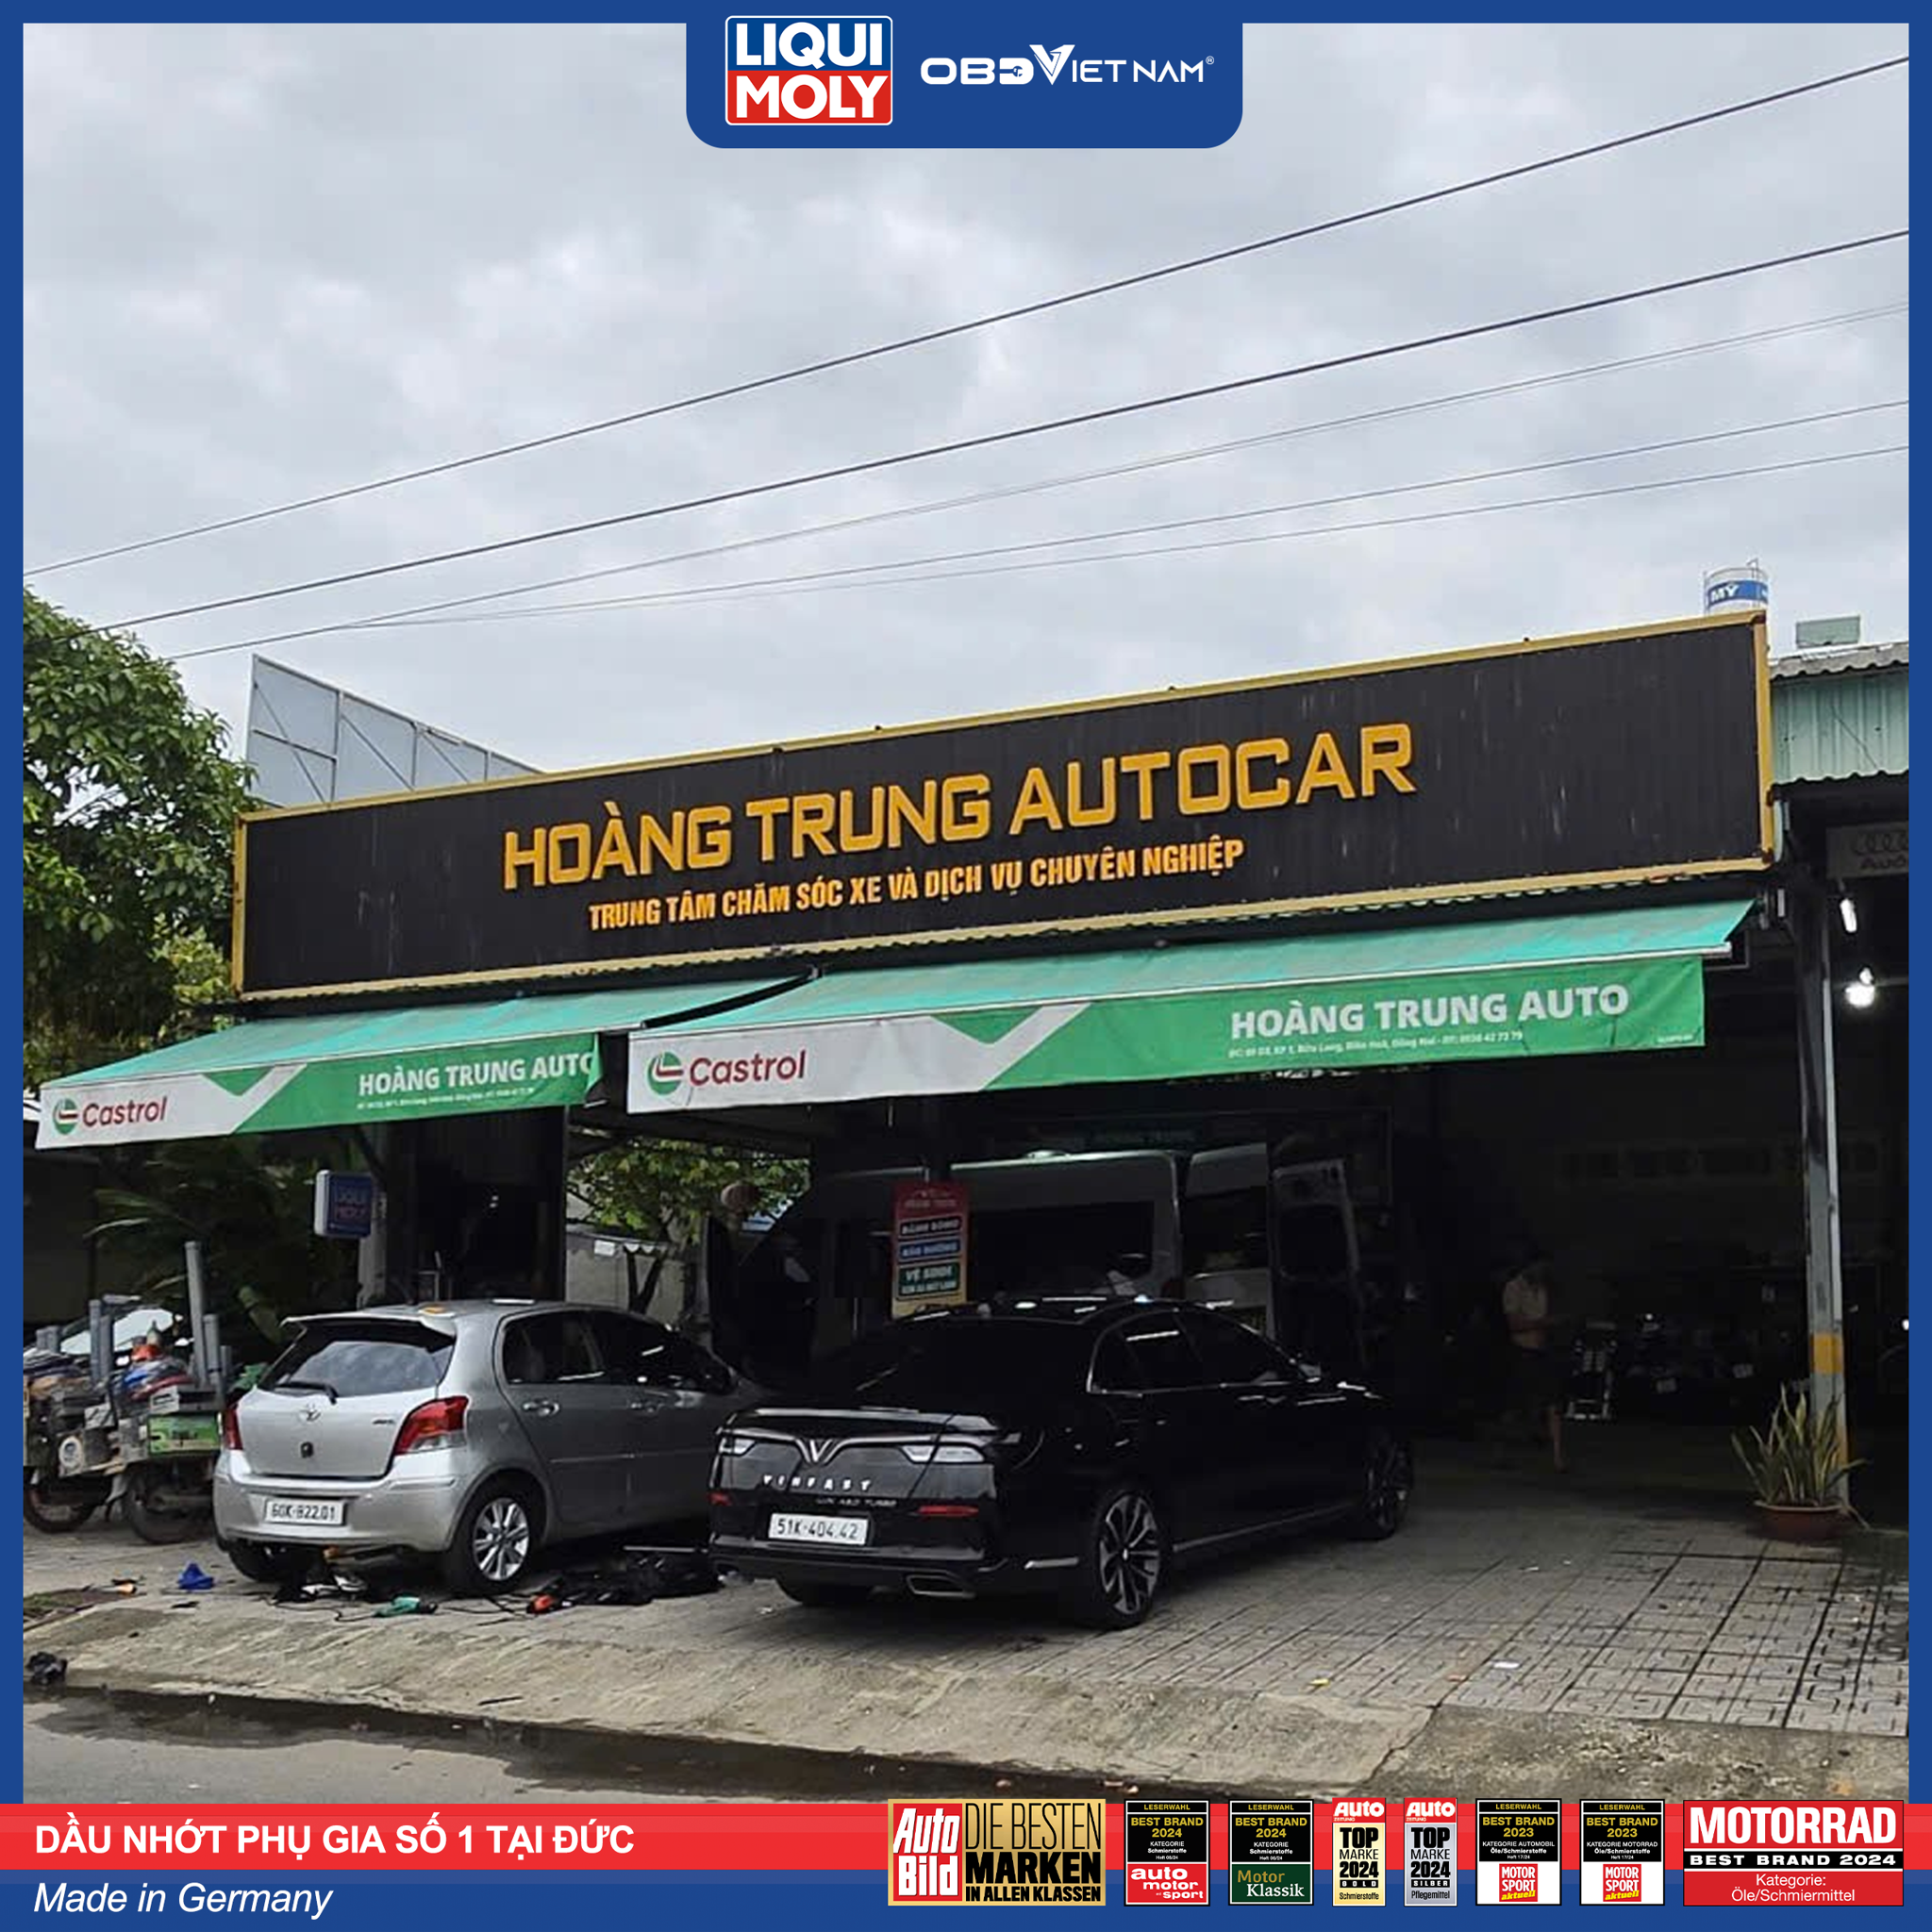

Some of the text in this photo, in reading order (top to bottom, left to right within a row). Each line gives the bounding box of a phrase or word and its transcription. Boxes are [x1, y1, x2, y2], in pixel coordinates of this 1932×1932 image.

[503, 722, 1417, 891] HOÀNG TRUNG AUTOCAR
[589, 833, 1245, 932] TRUNG TÂM CHĂM SÓC XE VÀ DỊCH VỤ CHUYÊN NGHIỆP
[1231, 983, 1630, 1040] HOÀNG TRUNG AUTO
[358, 1066, 441, 1096] HOÀNG
[445, 1059, 525, 1087] TRUNG
[689, 1050, 807, 1087] Castrol
[82, 1095, 167, 1127] Castrol
